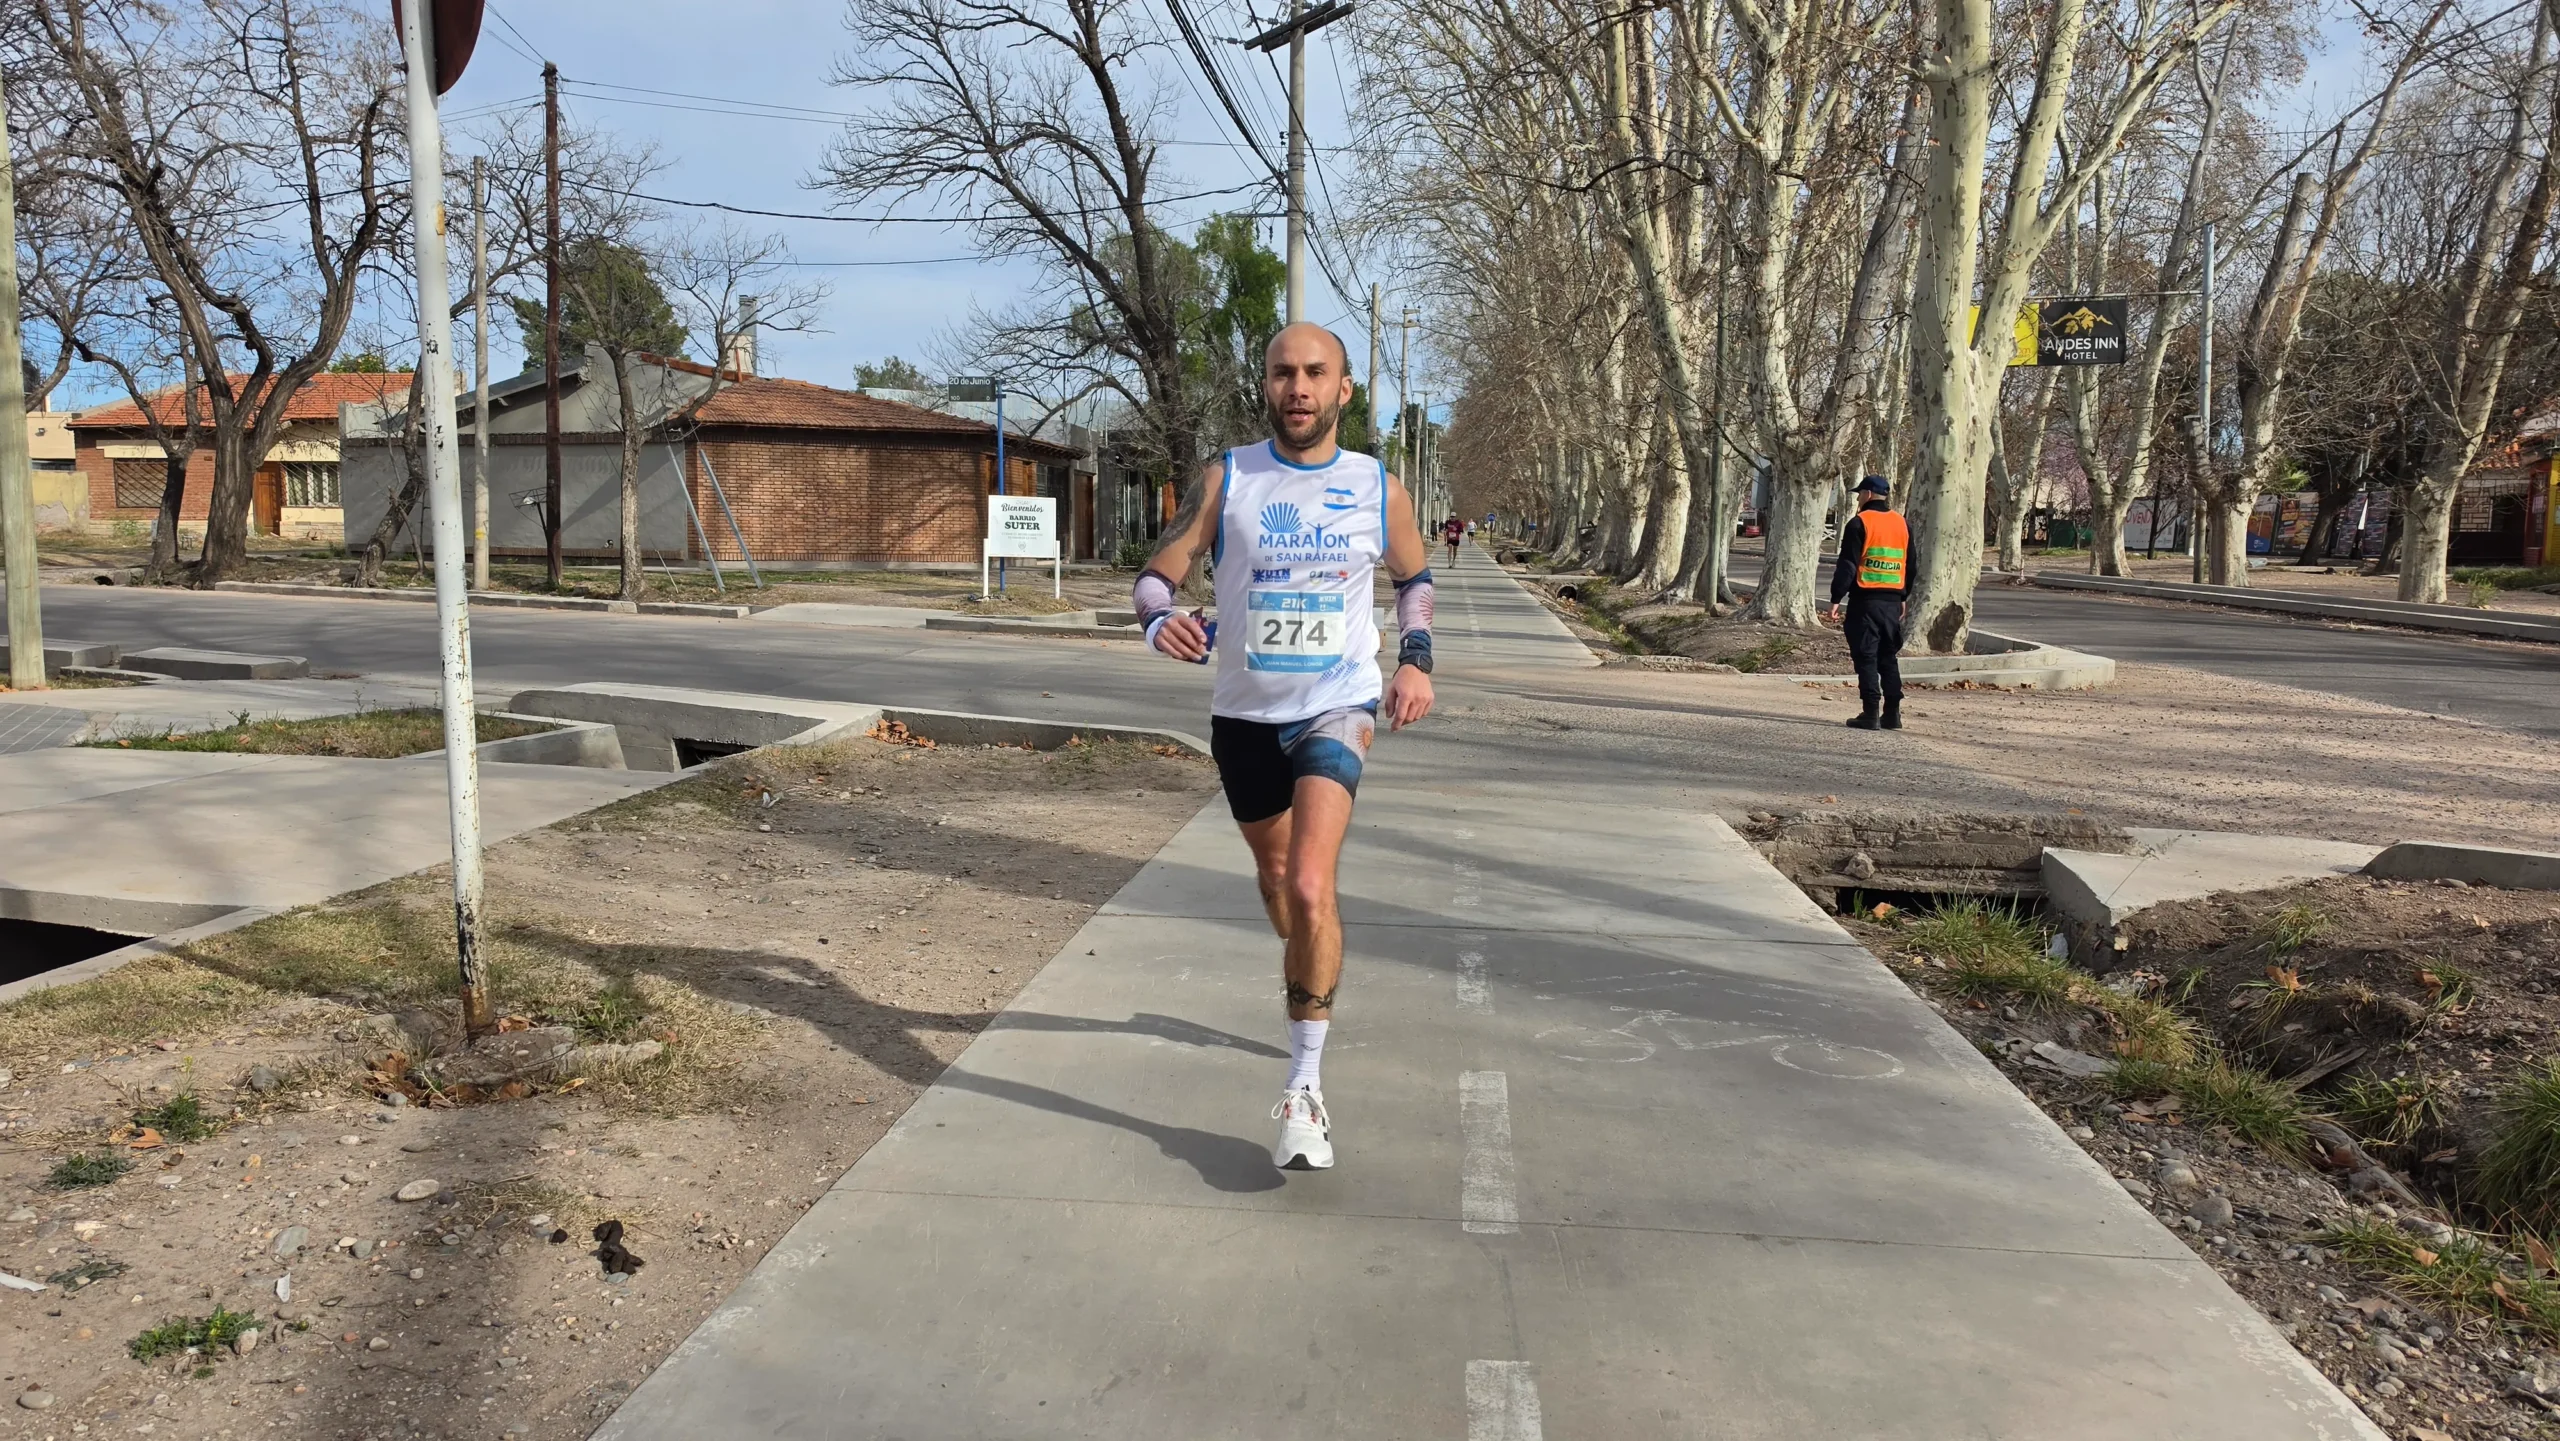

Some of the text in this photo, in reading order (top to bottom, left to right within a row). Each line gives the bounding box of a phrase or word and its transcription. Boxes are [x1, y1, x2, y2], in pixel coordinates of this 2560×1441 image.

[2045, 337, 2119, 351] ANDES INN
[2064, 352, 2098, 360] HOTEL
[949, 377, 991, 385] 20 de Junio
[1001, 503, 1044, 513] Bienvenidos
[1004, 521, 1041, 530] SUTER
[1276, 553, 1302, 562] SAN
[1305, 552, 1349, 562] RAFAEL
[1865, 559, 1901, 570] POLICIA
[1265, 568, 1291, 577] UTN
[1281, 597, 1308, 609] 21K
[1262, 619, 1328, 647] 274
